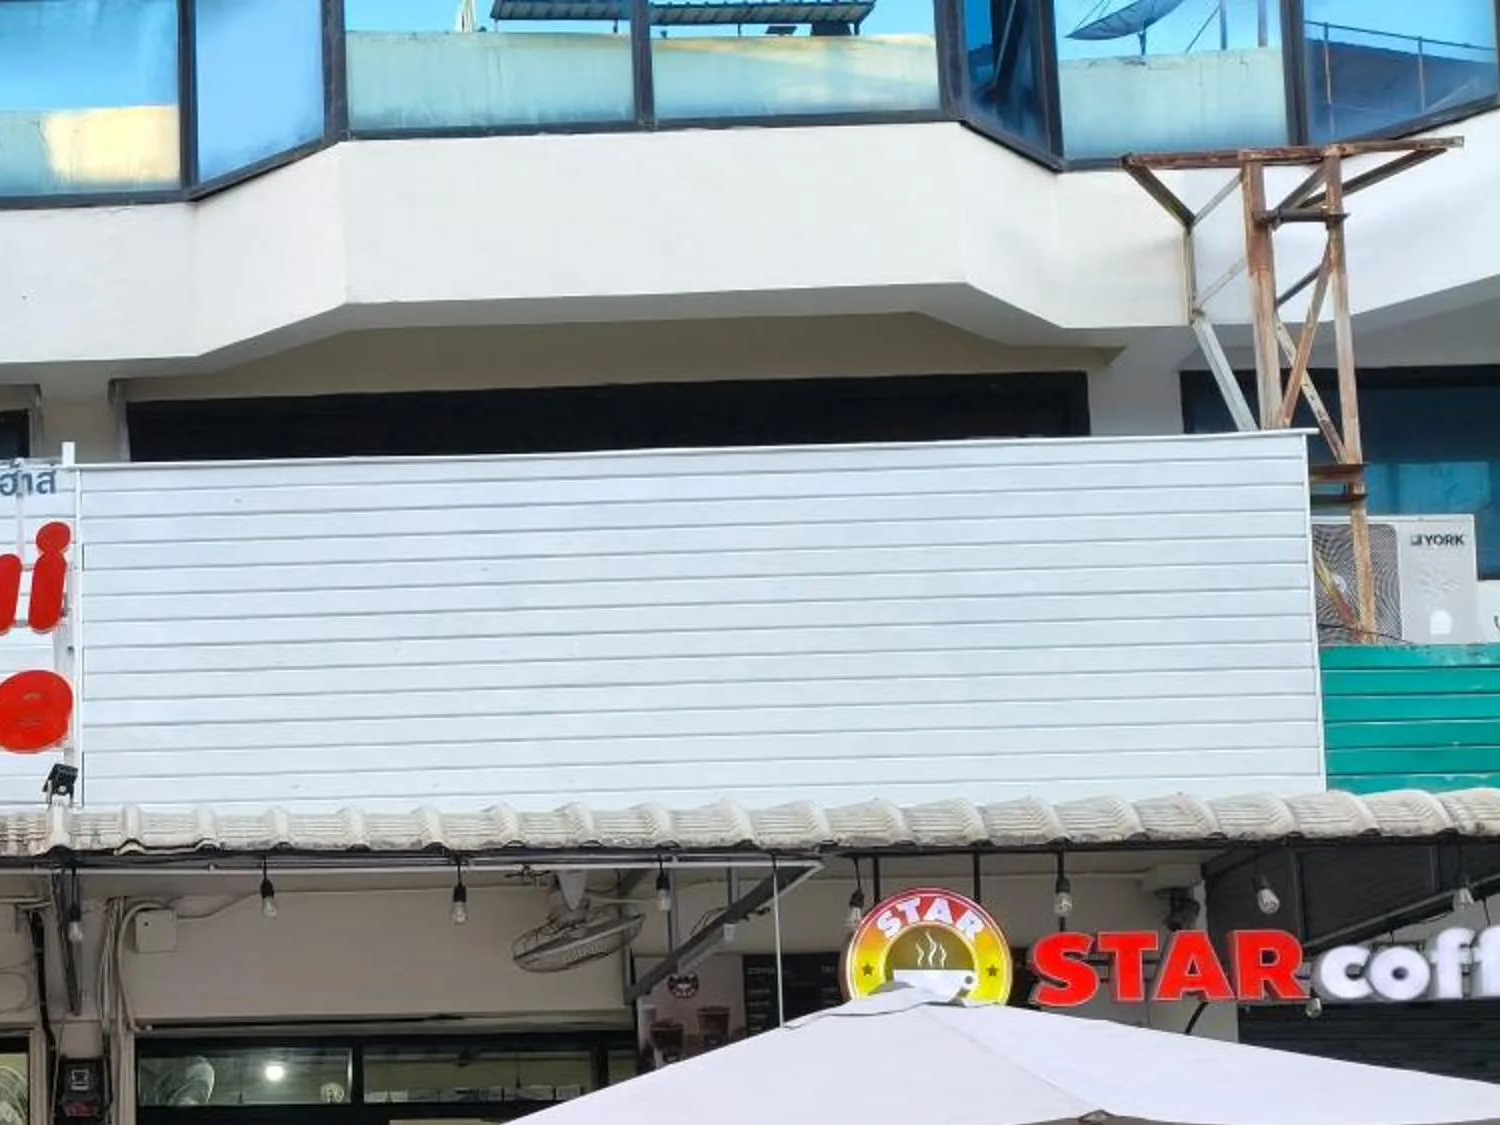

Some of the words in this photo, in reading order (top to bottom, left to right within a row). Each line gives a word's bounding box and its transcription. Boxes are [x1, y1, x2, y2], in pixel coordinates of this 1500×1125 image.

[1424, 534, 1466, 546] YORK
[877, 897, 985, 940] STAR
[1031, 929, 1311, 1007] STAR
